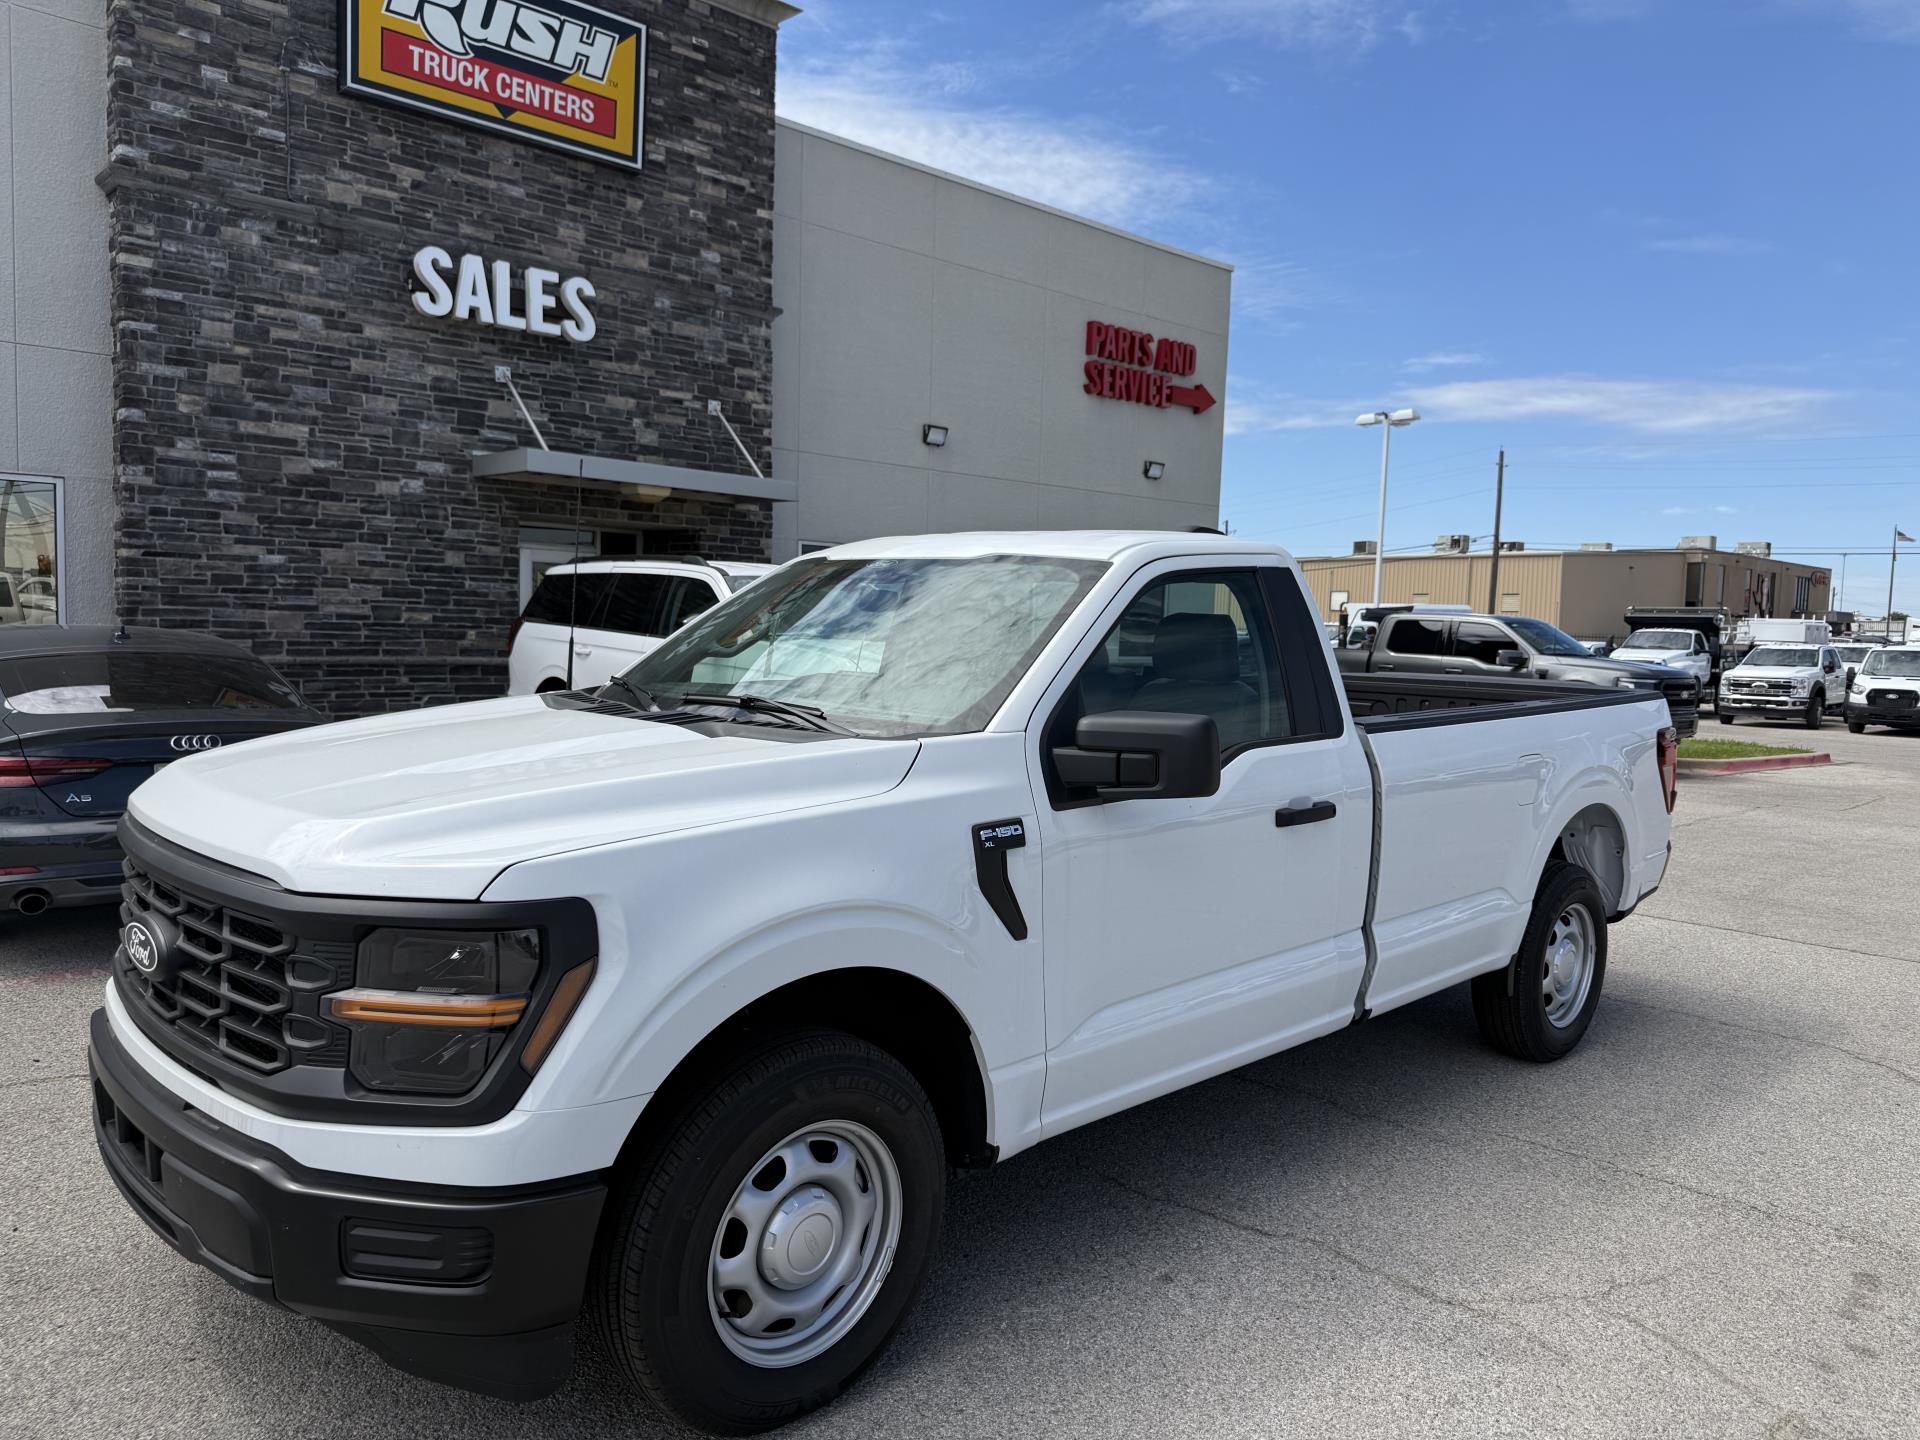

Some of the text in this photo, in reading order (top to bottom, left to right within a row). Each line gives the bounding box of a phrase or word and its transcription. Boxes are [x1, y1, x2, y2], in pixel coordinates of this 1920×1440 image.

[408, 45, 595, 124] TRUCK CENTERS
[411, 245, 597, 342] SALES
[1085, 320, 1197, 376] PARTS AND
[1083, 360, 1172, 409] SERVICE
[65, 792, 92, 803] A5
[980, 824, 1022, 840] F-150
[130, 927, 151, 966] Ford
